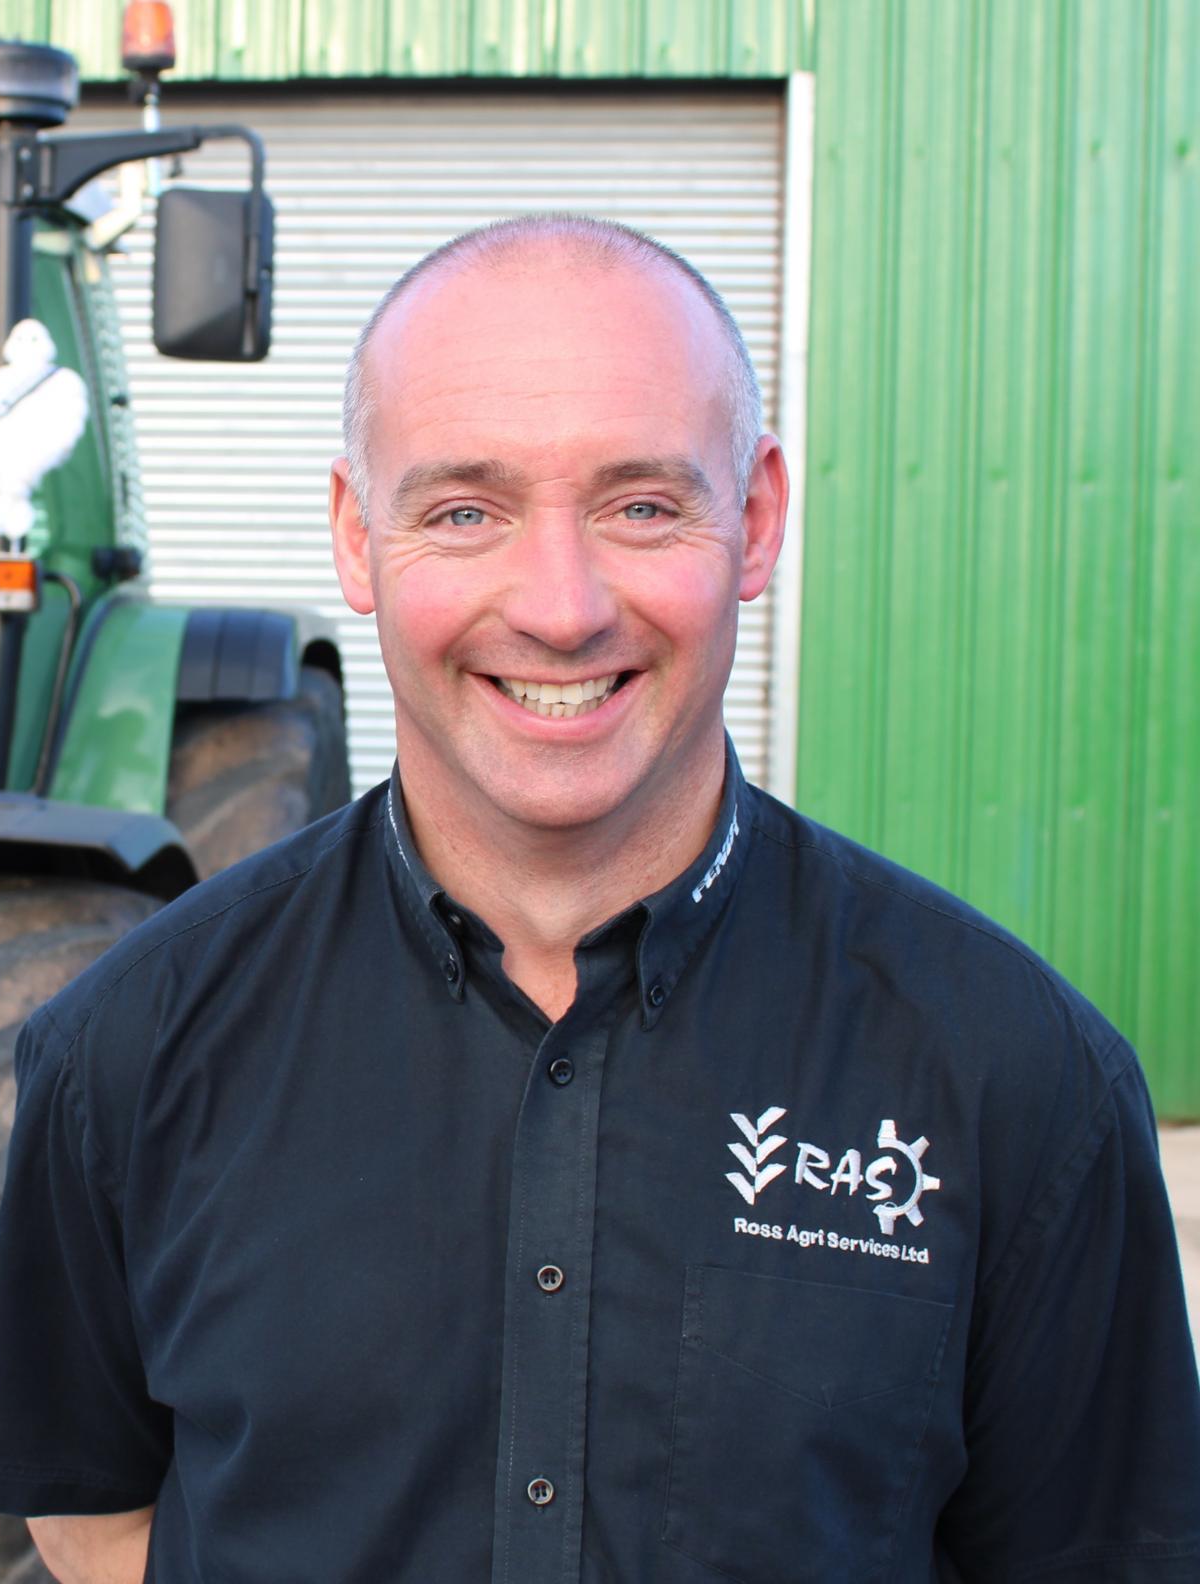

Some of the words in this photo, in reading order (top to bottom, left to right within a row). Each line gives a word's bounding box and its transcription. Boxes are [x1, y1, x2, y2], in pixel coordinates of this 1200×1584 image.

[794, 1142, 898, 1201] RAS
[733, 1217, 784, 1241] Ross
[786, 1224, 824, 1248] Agri
[827, 1231, 901, 1259] Services
[901, 1244, 930, 1264] Ltd
